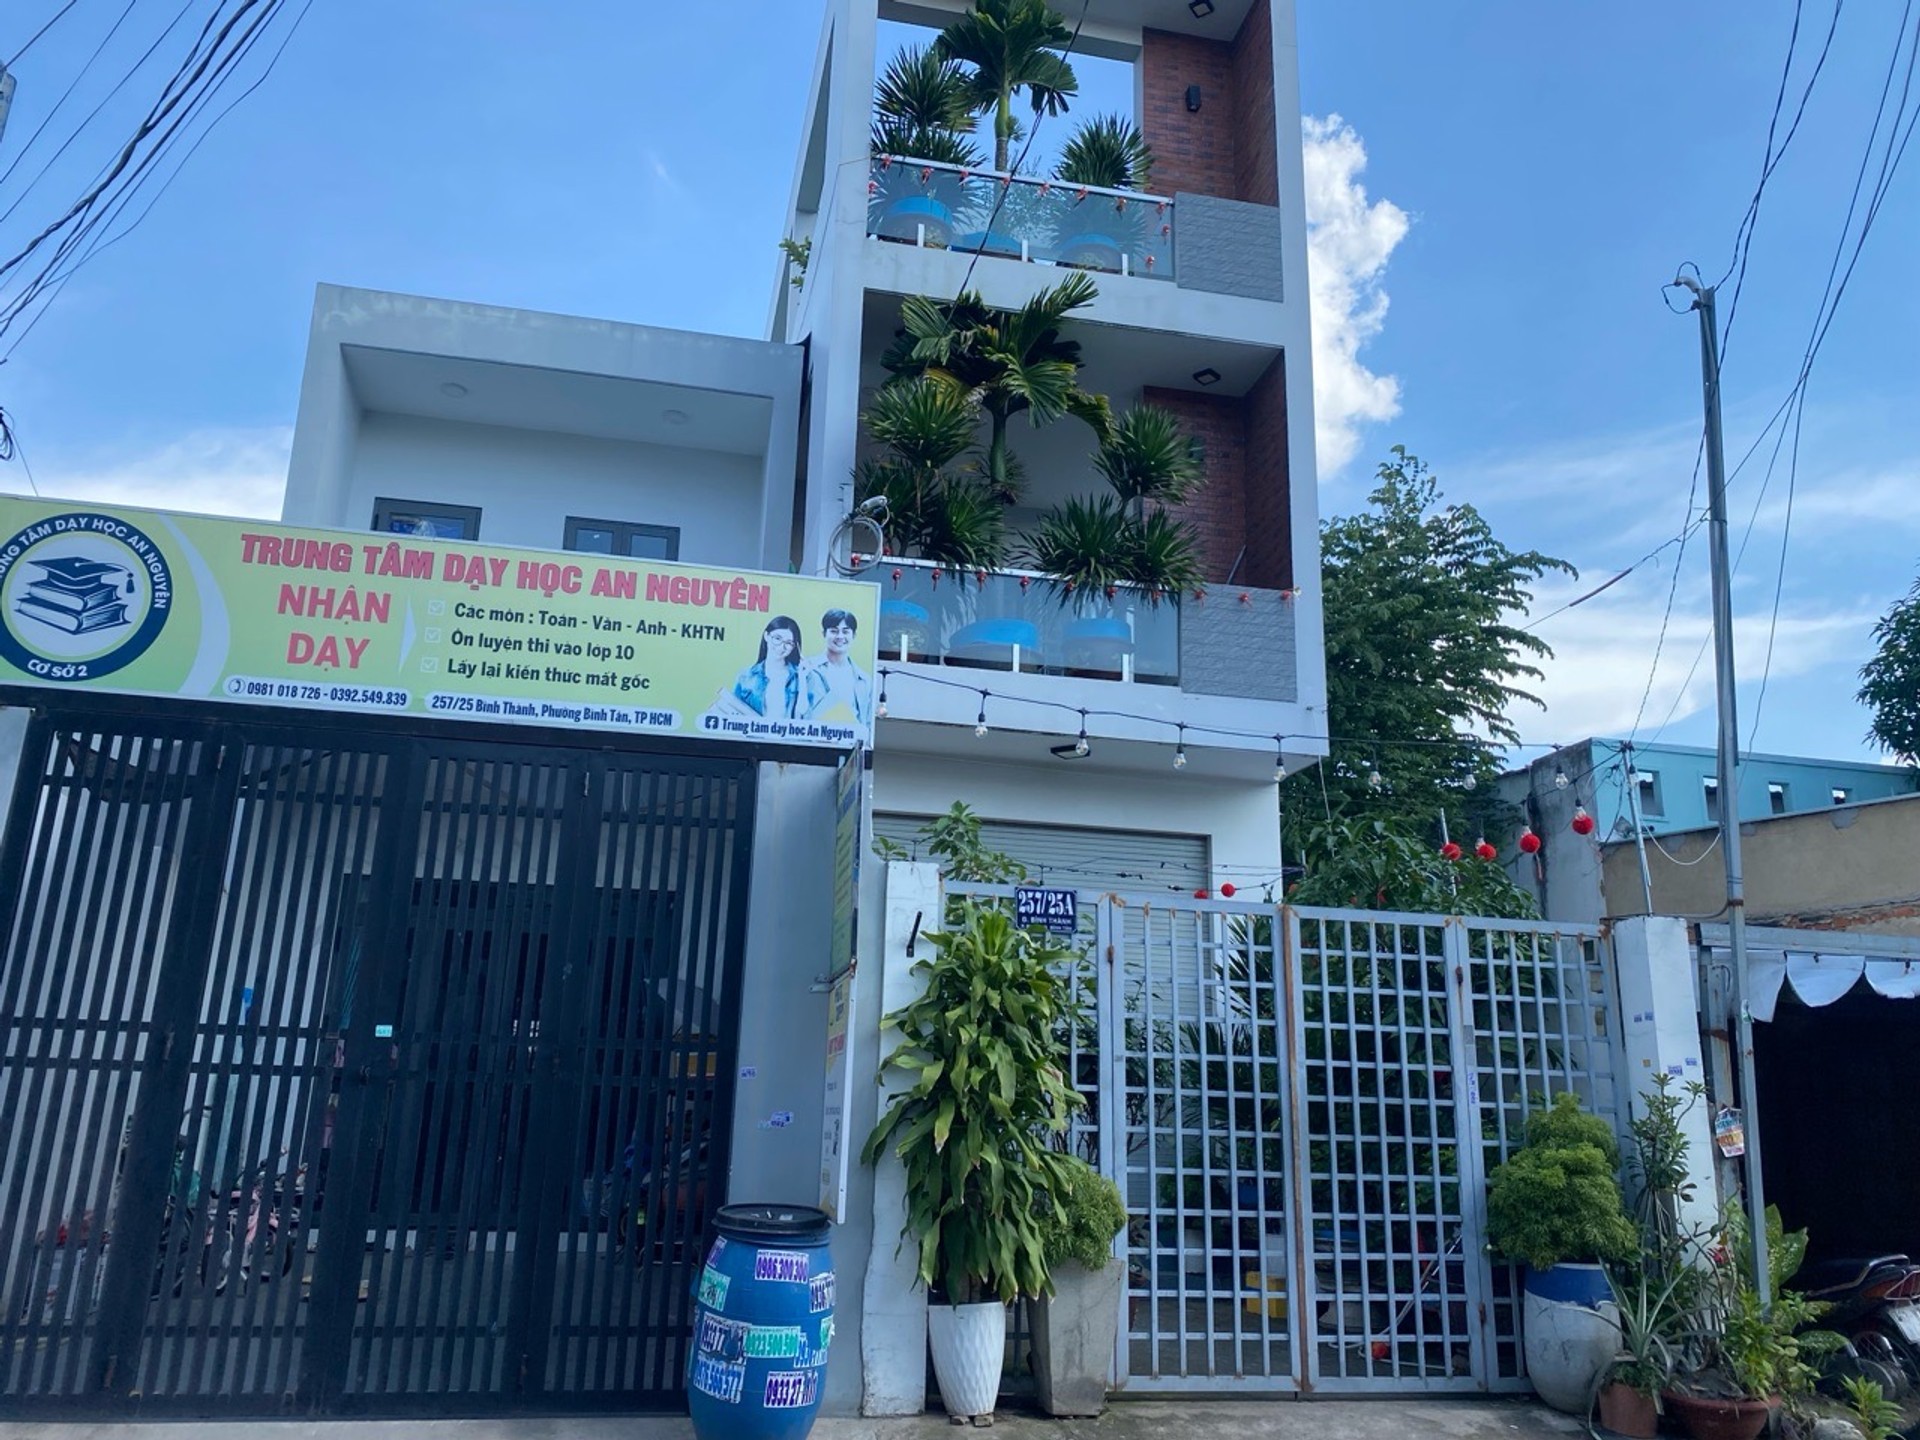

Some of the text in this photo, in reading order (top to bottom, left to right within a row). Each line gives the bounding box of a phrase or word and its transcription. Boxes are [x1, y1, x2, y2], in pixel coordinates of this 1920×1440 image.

[19, 523, 52, 546] TÂM
[55, 517, 88, 533] DẠY
[92, 518, 127, 536] HỌC
[128, 535, 149, 553] AN
[144, 552, 170, 609] NGUYÊN
[241, 533, 771, 613] TRUNG TÂM DẠY HỌC AN NGUYÊN
[278, 583, 391, 625] NHẬN
[636, 619, 667, 636] Anh
[681, 623, 725, 642] KHTN
[287, 632, 371, 673] DẠY
[527, 637, 550, 653] thi
[615, 644, 635, 660] 10
[78, 665, 88, 677] 2
[481, 661, 501, 679] lại
[247, 682, 274, 697] 0981
[278, 684, 298, 698] 018
[301, 686, 321, 700] 726
[330, 688, 407, 706] 0392.549.839
[431, 695, 474, 711] 257/25
[722, 718, 749, 734] Trung
[807, 724, 819, 737] An
[1018, 890, 1074, 916] 257/25A
